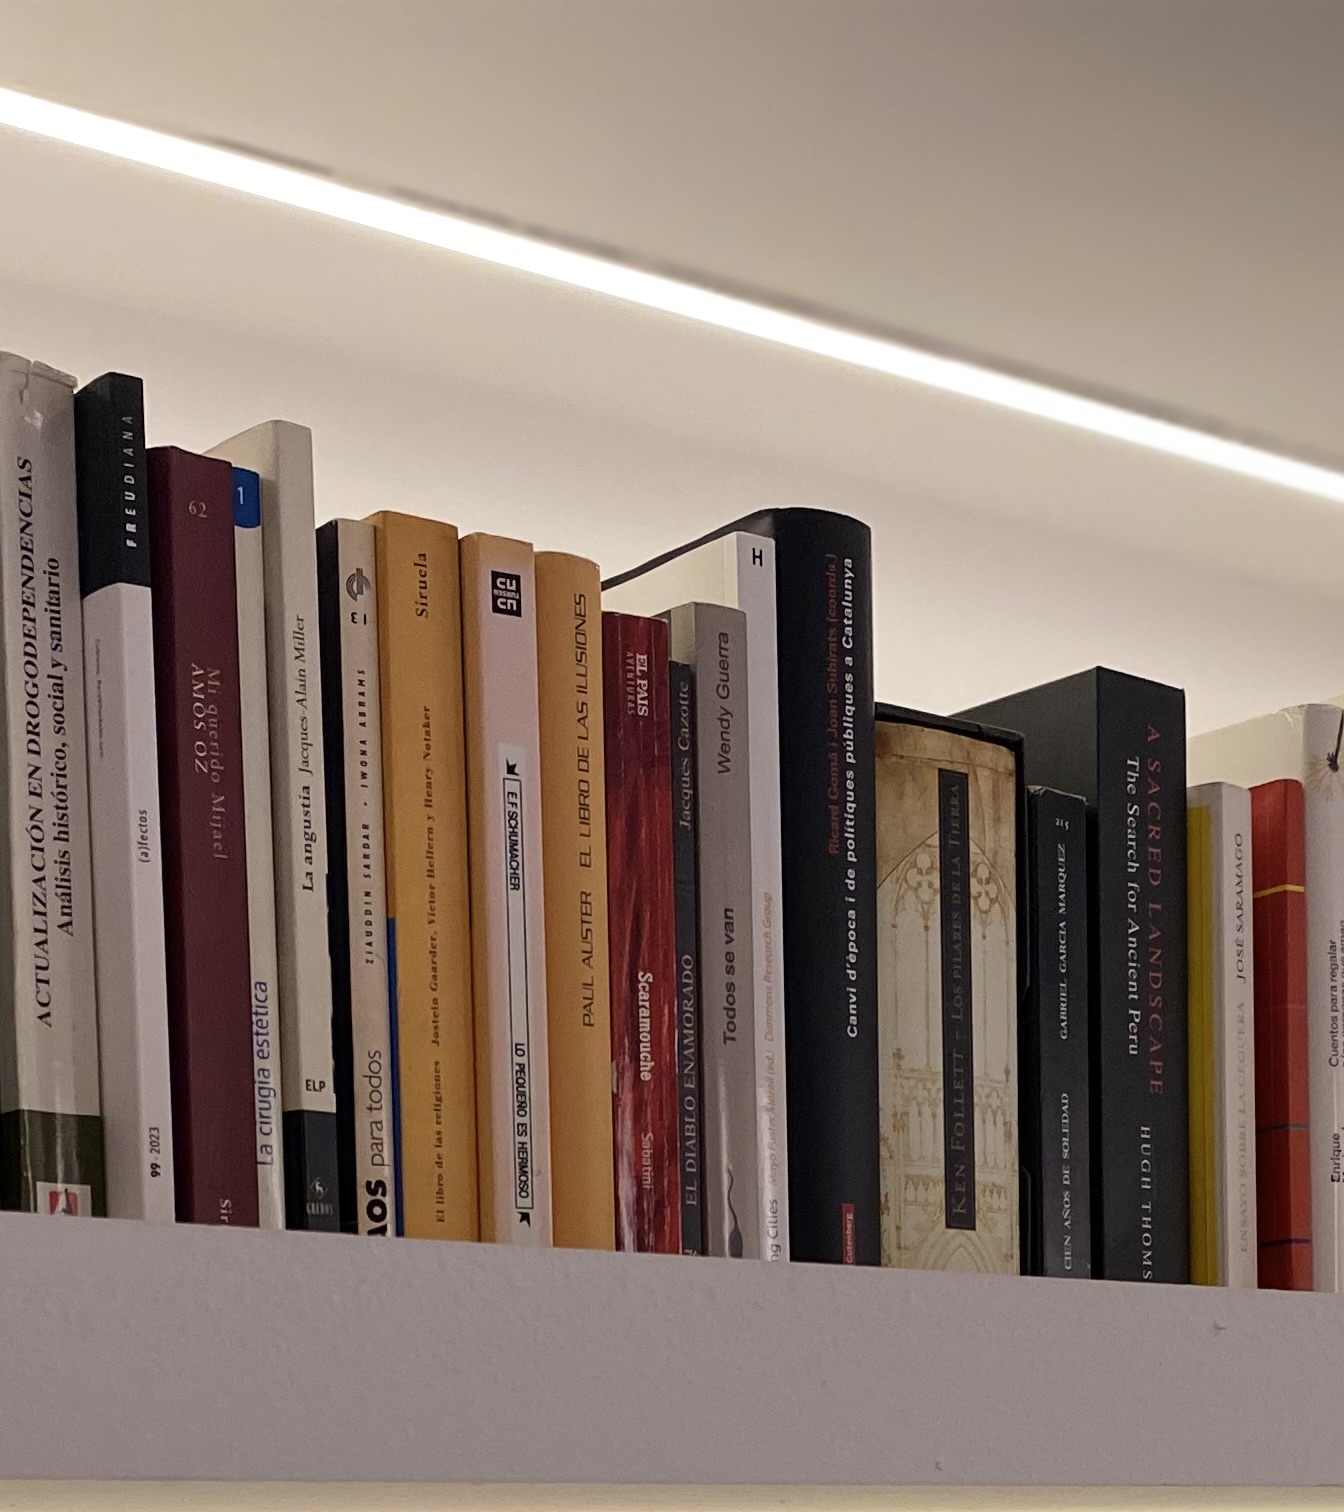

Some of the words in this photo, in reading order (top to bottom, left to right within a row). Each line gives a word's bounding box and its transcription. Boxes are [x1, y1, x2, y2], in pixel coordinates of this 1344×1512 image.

[121, 416, 136, 547] FREUDIANA
[17, 456, 41, 756] DROGODEPENDENCIAS
[42, 557, 62, 652] sanitario
[413, 552, 428, 618] Siruela
[841, 558, 854, 648] Catalunya
[51, 658, 67, 671] y
[573, 593, 587, 694] ILUSIONES
[715, 631, 730, 699] Guerra
[844, 656, 853, 666] a
[46, 673, 65, 735] social
[576, 701, 588, 740] LAS
[576, 746, 589, 772] DE
[716, 705, 733, 773] Wendy
[27, 762, 42, 798] EN
[50, 742, 69, 842] histórico,
[1126, 756, 1139, 794] The
[577, 779, 590, 837] LIBRO
[1126, 802, 1139, 872] Search
[579, 845, 591, 868] EL
[844, 868, 855, 890] de
[25, 805, 51, 1027] ACTUALIZACIÓN
[53, 849, 73, 936] Análisis
[1127, 882, 1140, 912] for
[579, 890, 593, 968] AUSTER
[723, 907, 734, 945] van
[724, 950, 735, 975] se
[1127, 918, 1140, 999] Ancient
[581, 977, 594, 1027] PAUL
[637, 971, 654, 1080] Scaramouche
[722, 981, 736, 1045] Todos
[845, 986, 857, 1037] Canvi
[1128, 1009, 1140, 1054] Peru
[362, 1050, 385, 1114] todos
[369, 1118, 389, 1168] para
